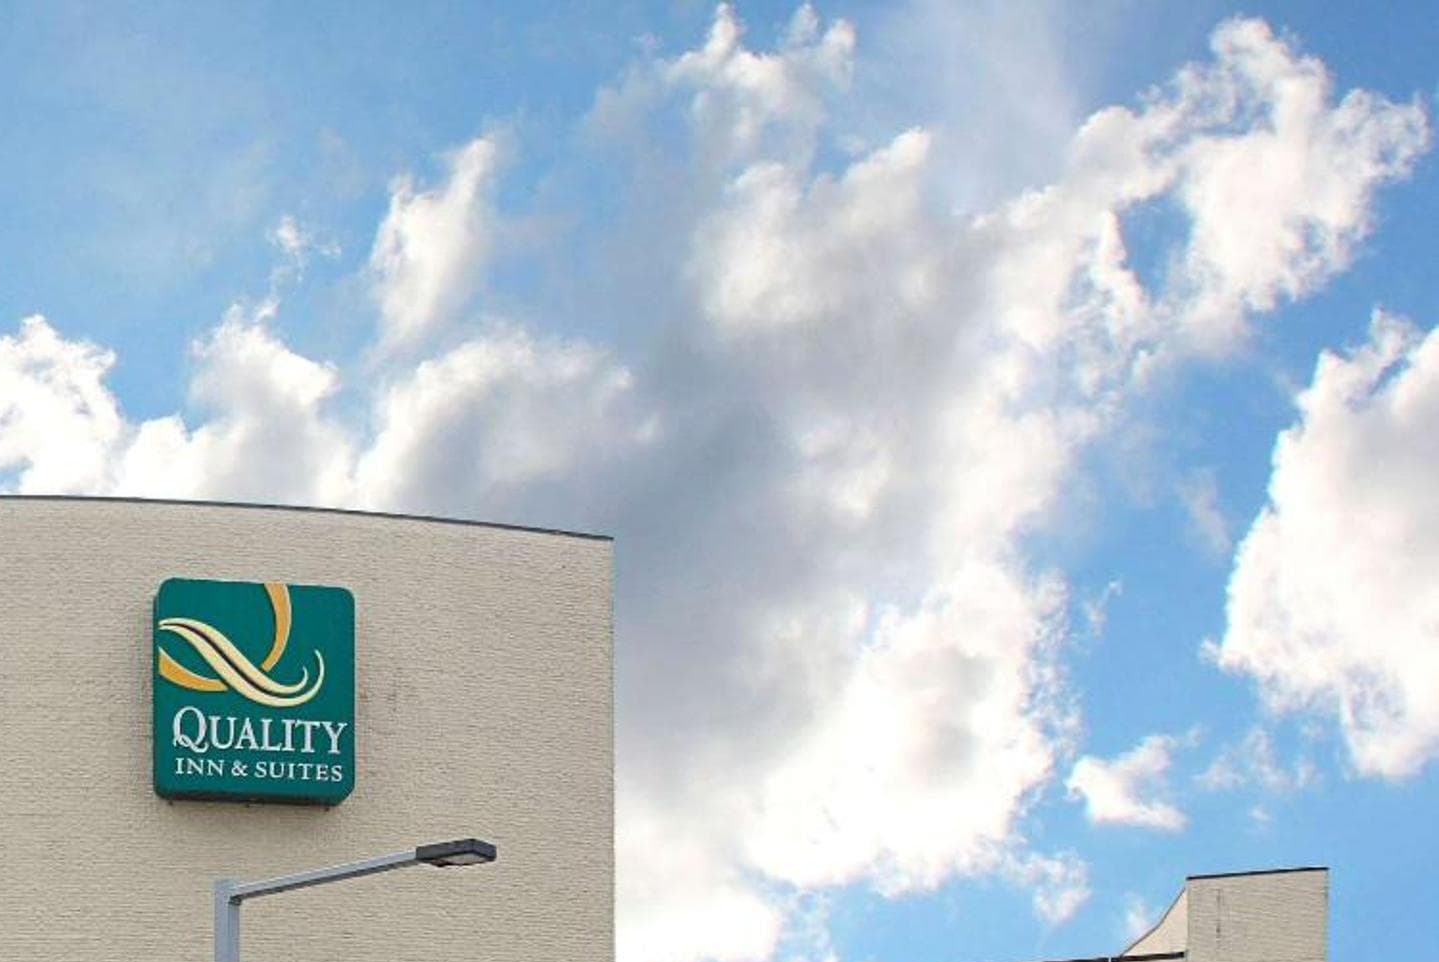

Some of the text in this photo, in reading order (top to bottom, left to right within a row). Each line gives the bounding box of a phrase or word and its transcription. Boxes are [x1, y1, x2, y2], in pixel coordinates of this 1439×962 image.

[172, 705, 348, 754] QUALITY
[175, 757, 343, 782] INN & SUITES
